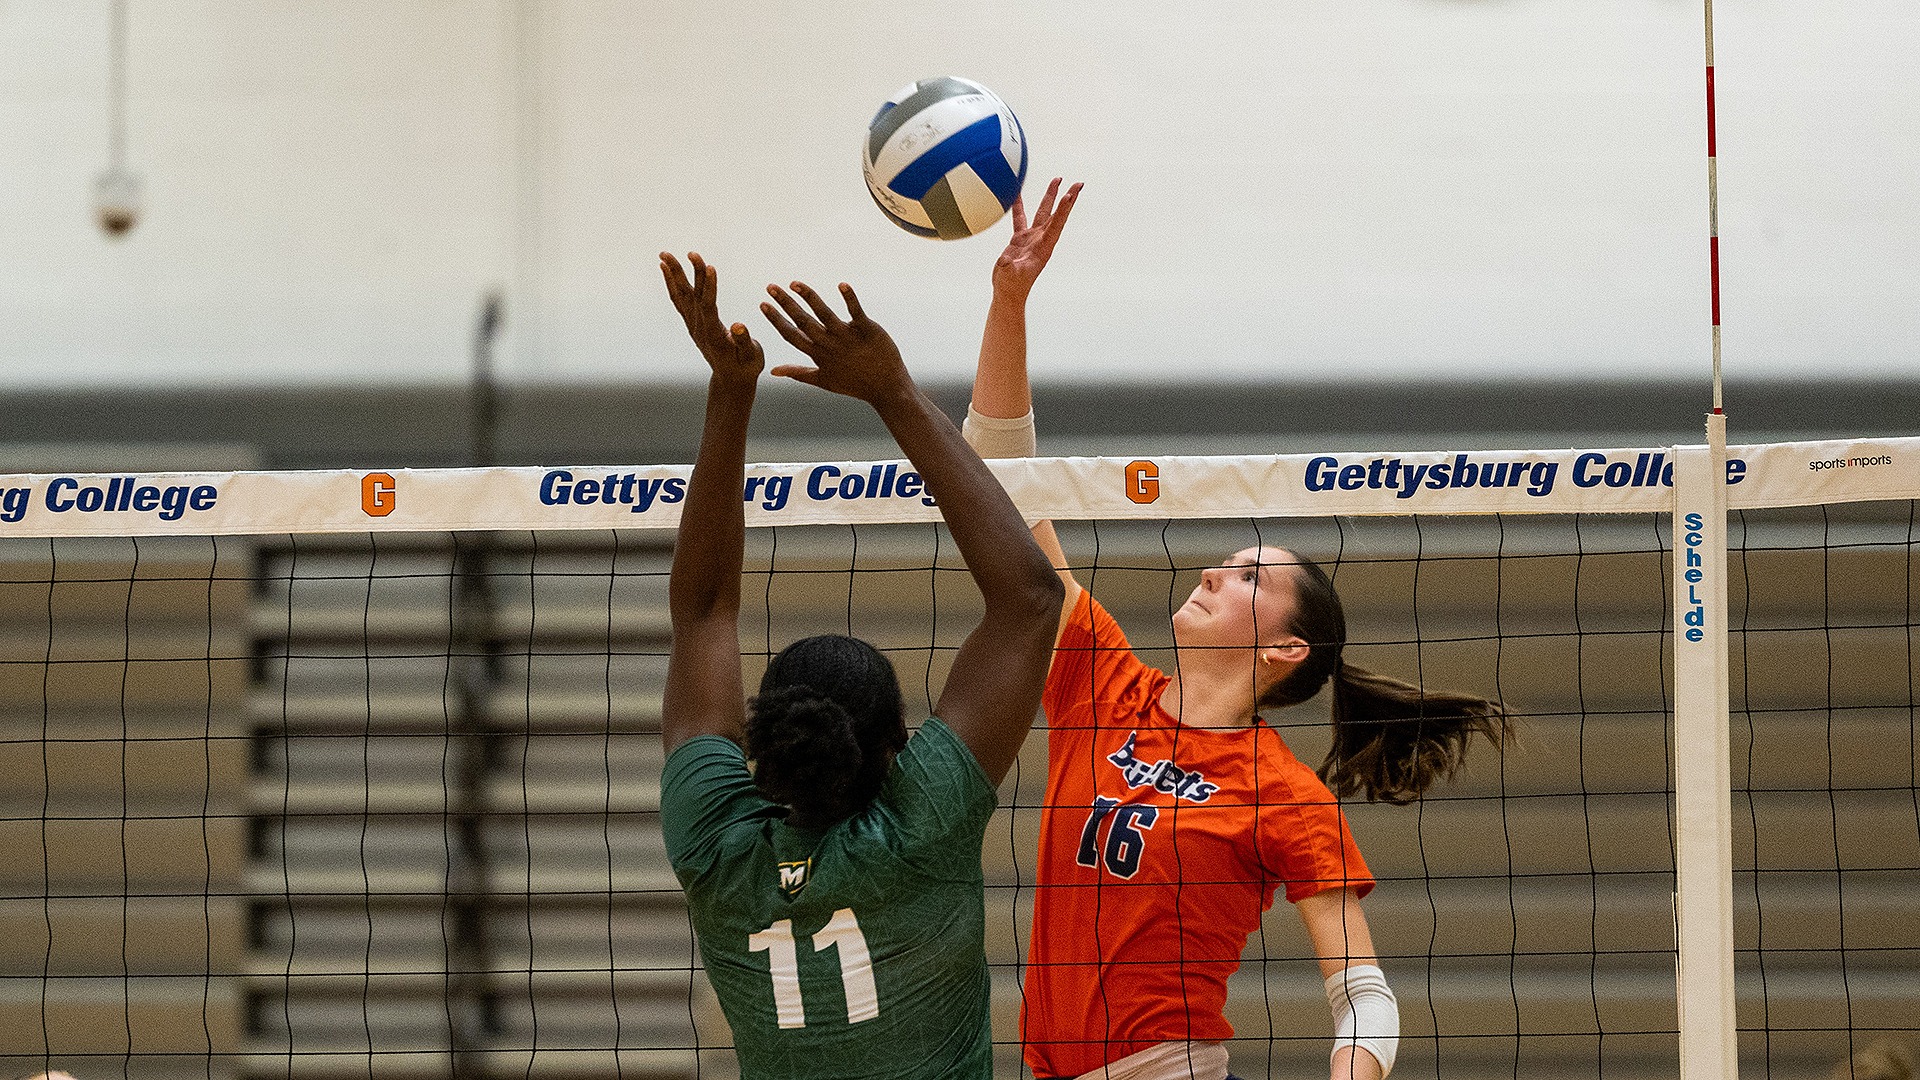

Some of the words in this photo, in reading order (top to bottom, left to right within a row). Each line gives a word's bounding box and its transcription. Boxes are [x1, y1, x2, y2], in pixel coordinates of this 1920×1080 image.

[1125, 460, 1160, 504] G
[1304, 454, 1559, 499] Gettysburg
[1572, 453, 1747, 488] Colle
[1809, 458, 1846, 472] sports
[1847, 454, 1892, 468] imports
[45, 477, 218, 521] College
[361, 472, 396, 517] G
[539, 470, 793, 513] Gettysrg
[807, 464, 939, 507] Colle
[1076, 795, 1159, 880] 16
[748, 907, 880, 1029] 11
